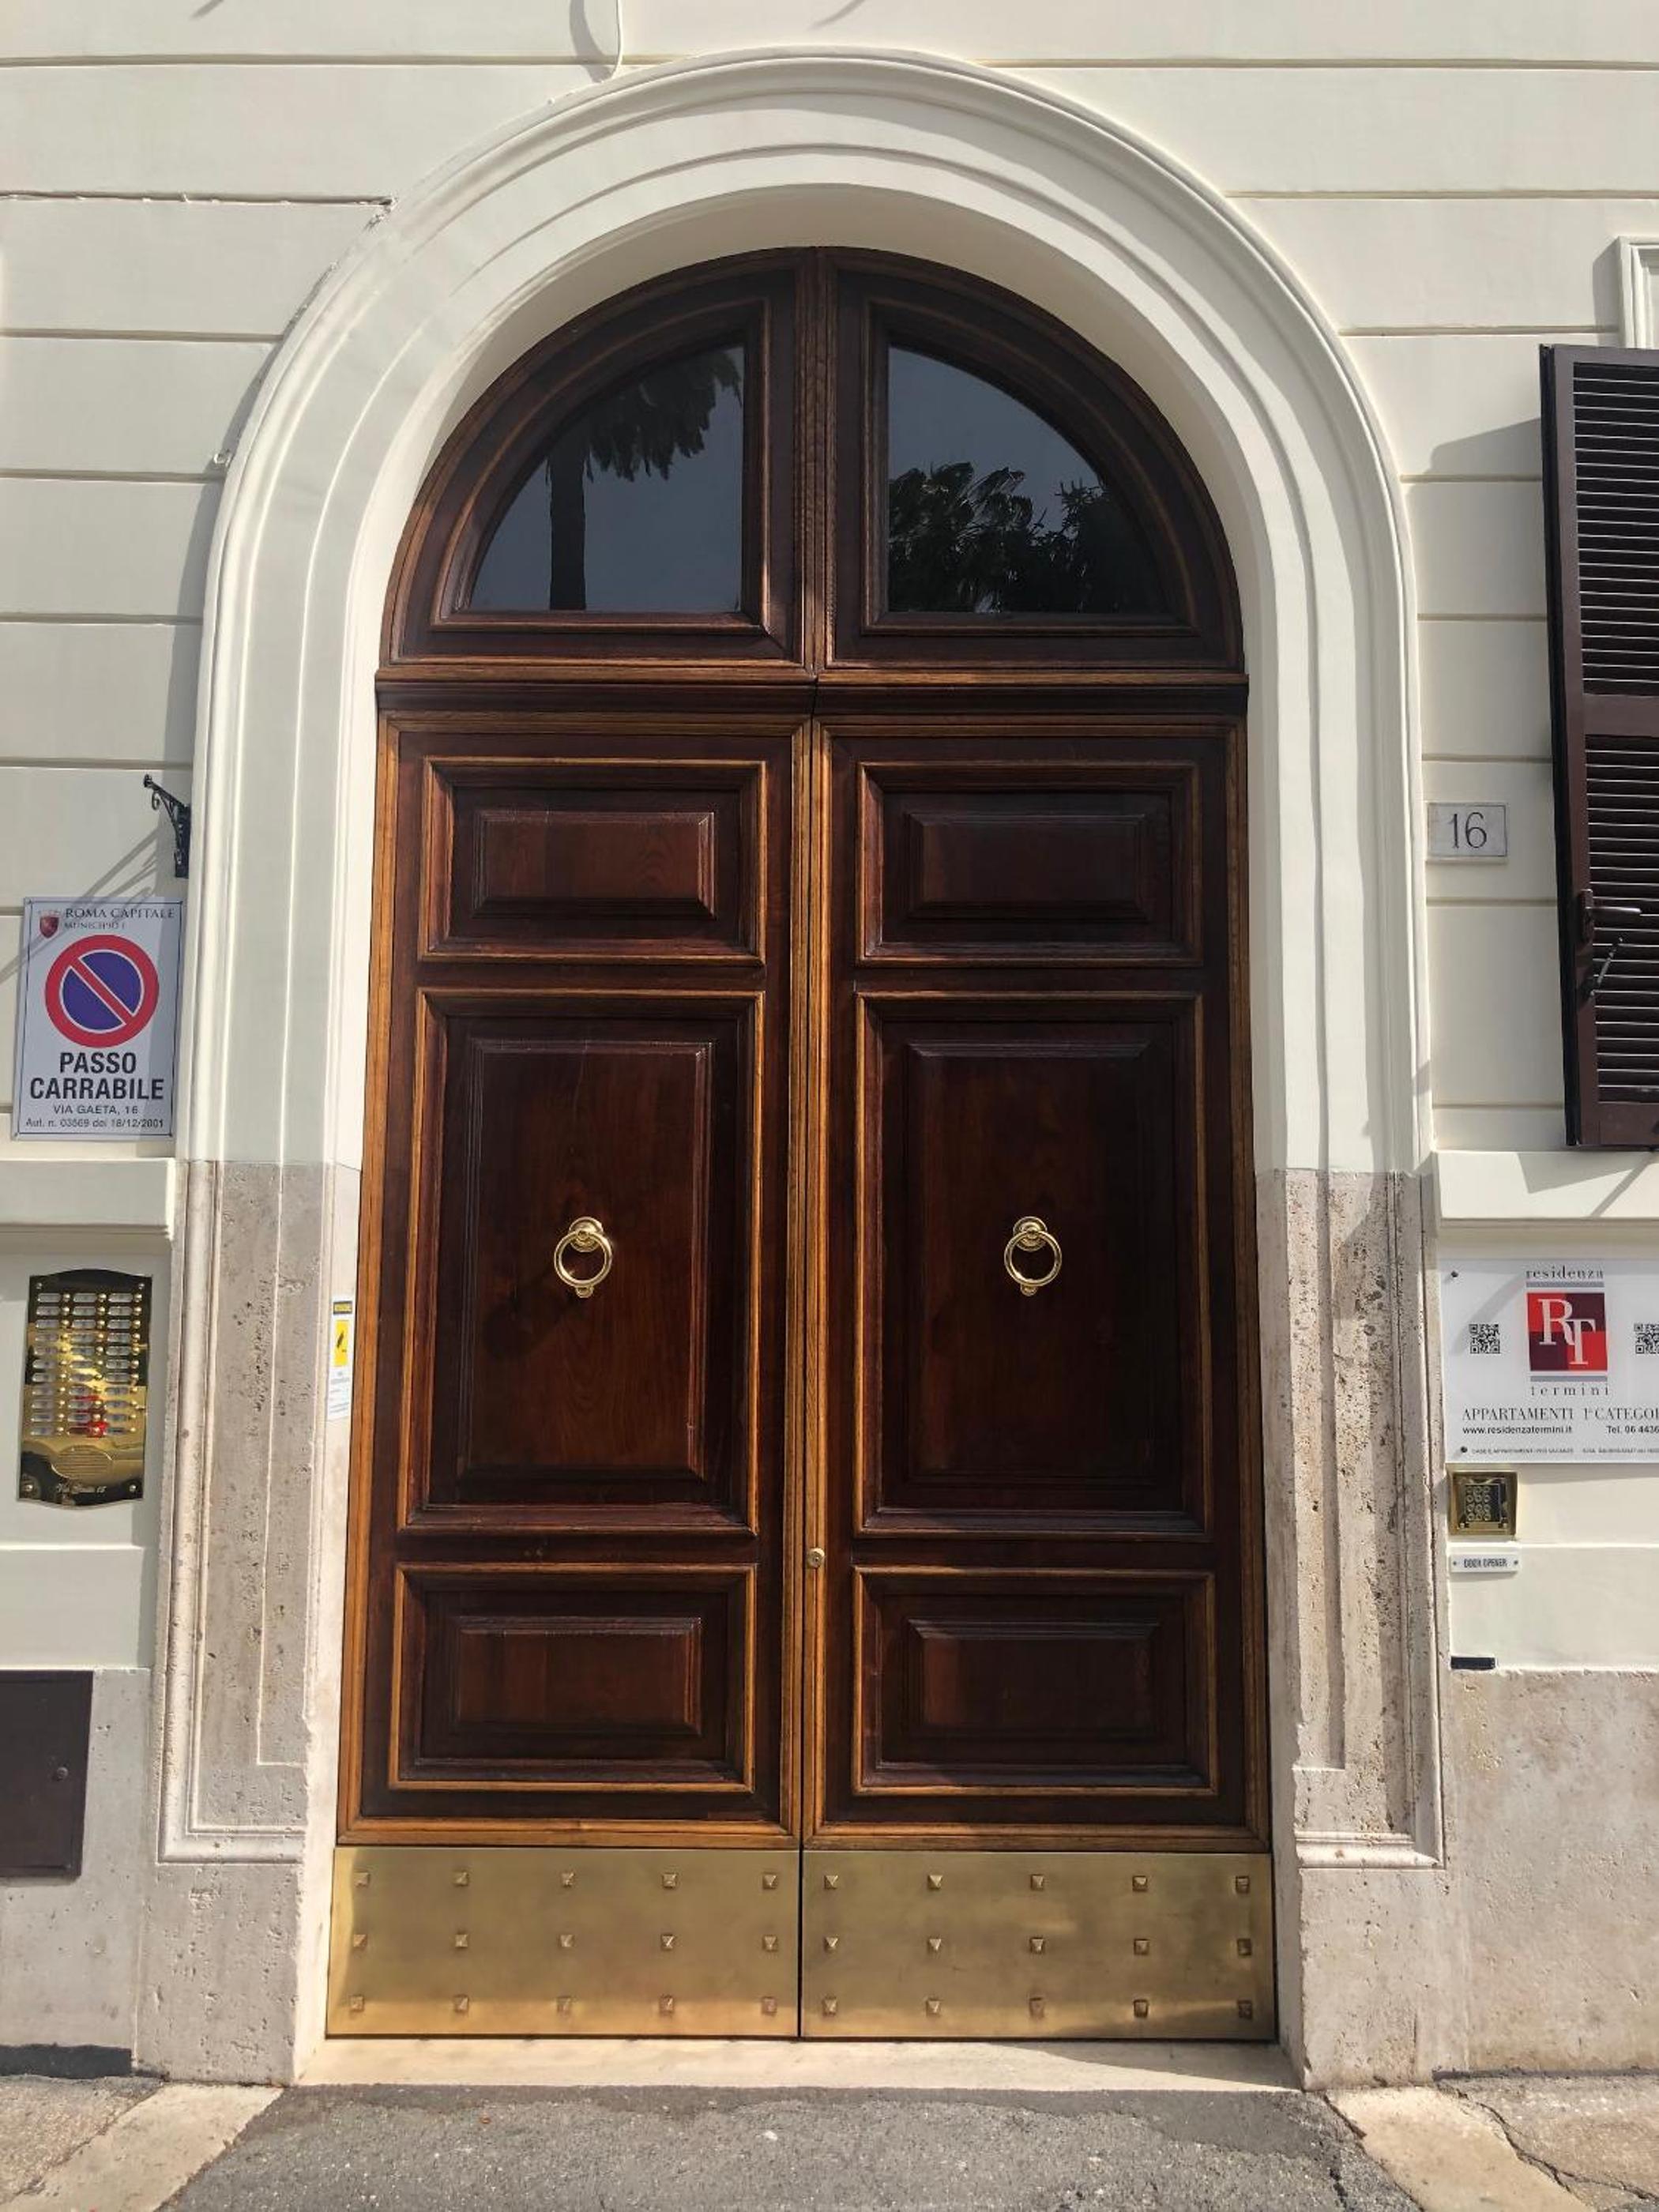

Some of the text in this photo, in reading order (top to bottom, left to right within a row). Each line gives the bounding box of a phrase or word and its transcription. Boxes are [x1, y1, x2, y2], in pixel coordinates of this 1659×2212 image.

[1448, 811, 1487, 848] 16
[66, 908, 175, 919] ROMA CAPITALE
[59, 1052, 137, 1074] PASSO
[30, 1078, 164, 1100] CARRABILE
[53, 1105, 138, 1116] VIA GAETA, 16
[1525, 1266, 1604, 1279] residenza
[1530, 1382, 1609, 1397] termini
[1462, 1407, 1573, 1420] APPARTAMENTI
[1462, 1425, 1573, 1435] www.residenzatermini.it
[1624, 1425, 1636, 1434] 06
